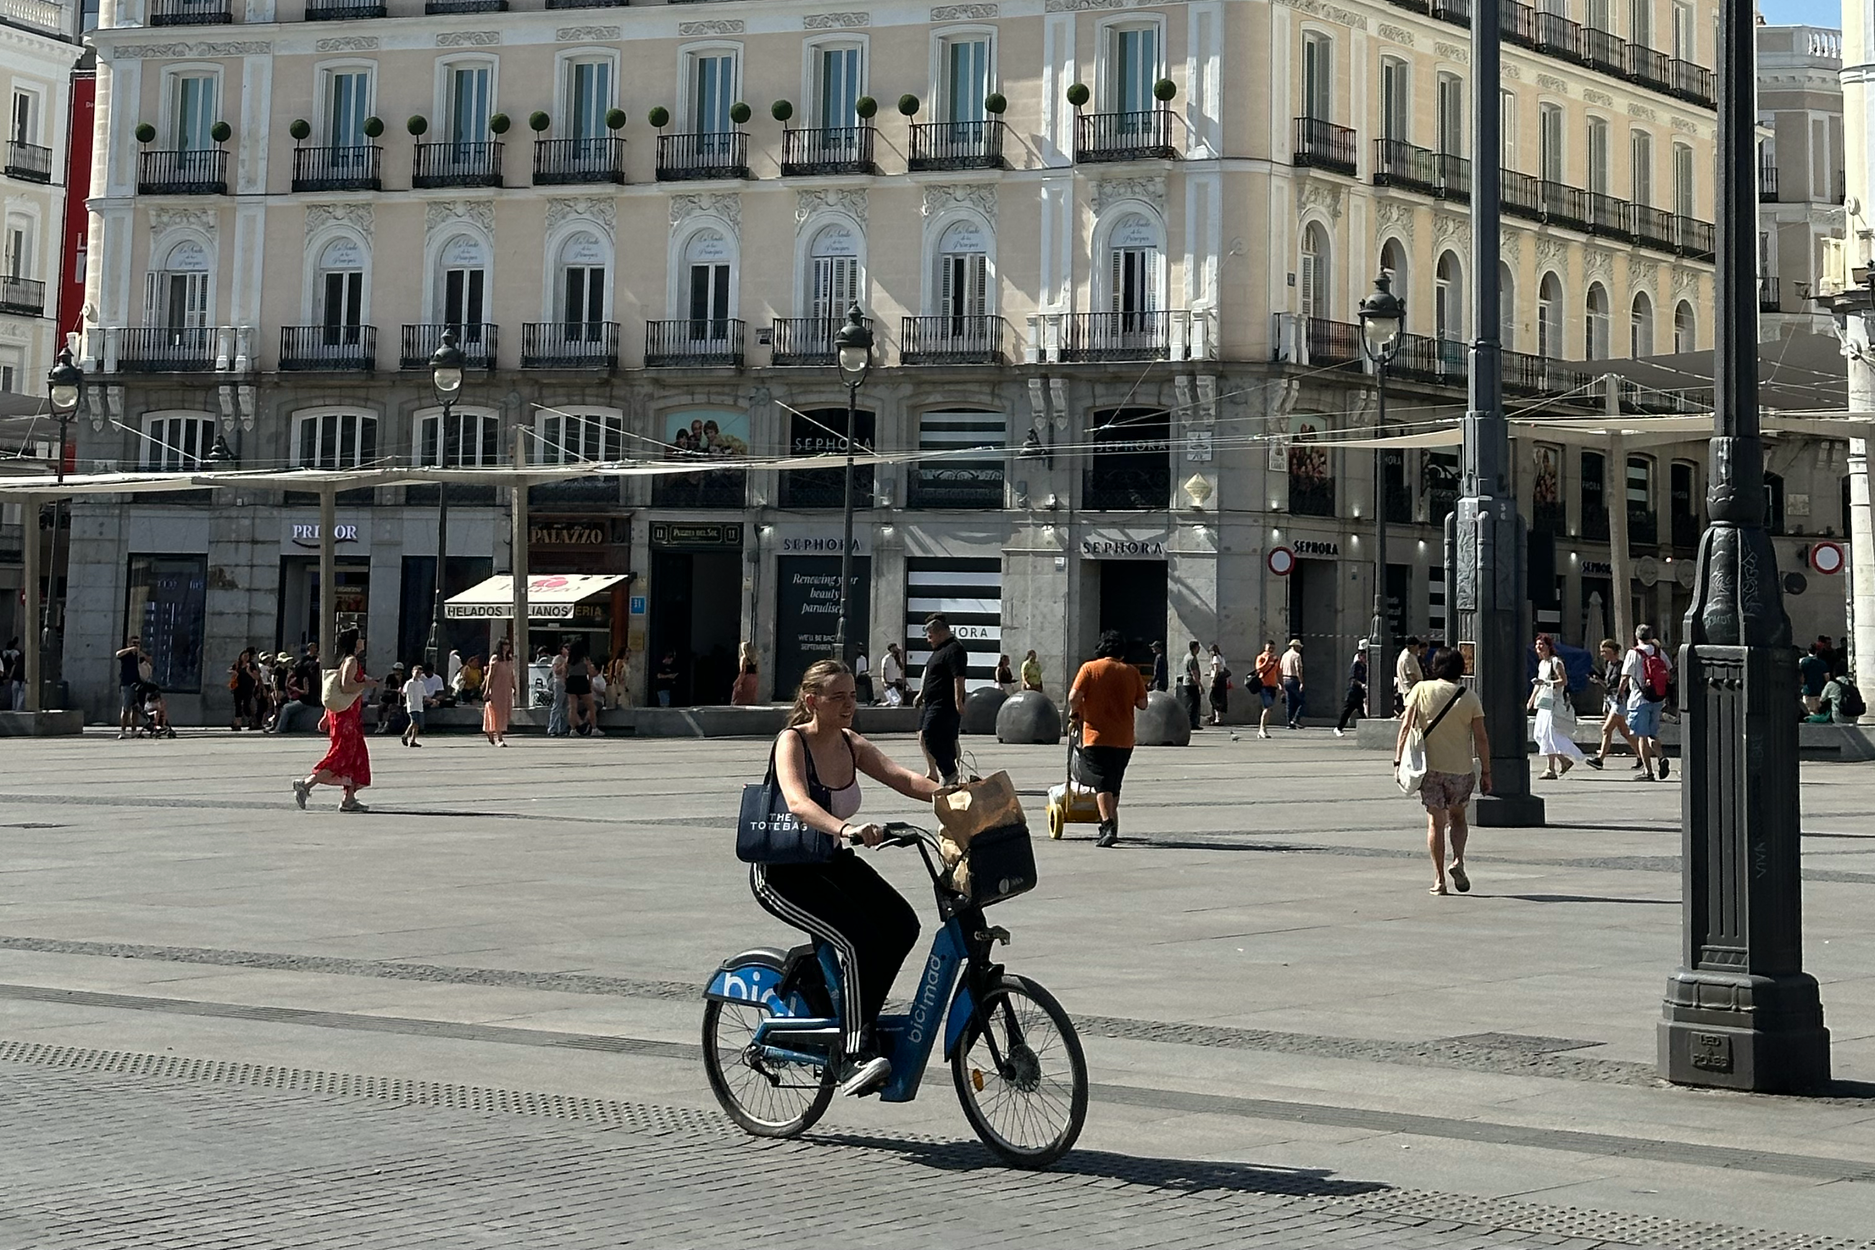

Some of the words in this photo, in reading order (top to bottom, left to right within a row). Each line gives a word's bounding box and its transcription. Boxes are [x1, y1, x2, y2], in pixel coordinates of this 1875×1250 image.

[292, 524, 358, 540] PRIOR
[529, 528, 603, 544] PALAZZO
[784, 538, 861, 551] SEPHOA
[1082, 541, 1163, 554] SEPHORA
[1293, 540, 1339, 556] SEPHORA
[793, 574, 836, 586] Renewing
[810, 587, 841, 601] beauty
[447, 606, 503, 617] HELADOS
[508, 606, 569, 617] IIANOS
[922, 626, 988, 638] SHORA
[769, 812, 793, 822] THE
[750, 821, 780, 831] TOTE
[782, 821, 808, 832] BAG
[907, 955, 943, 1044] bicimad
